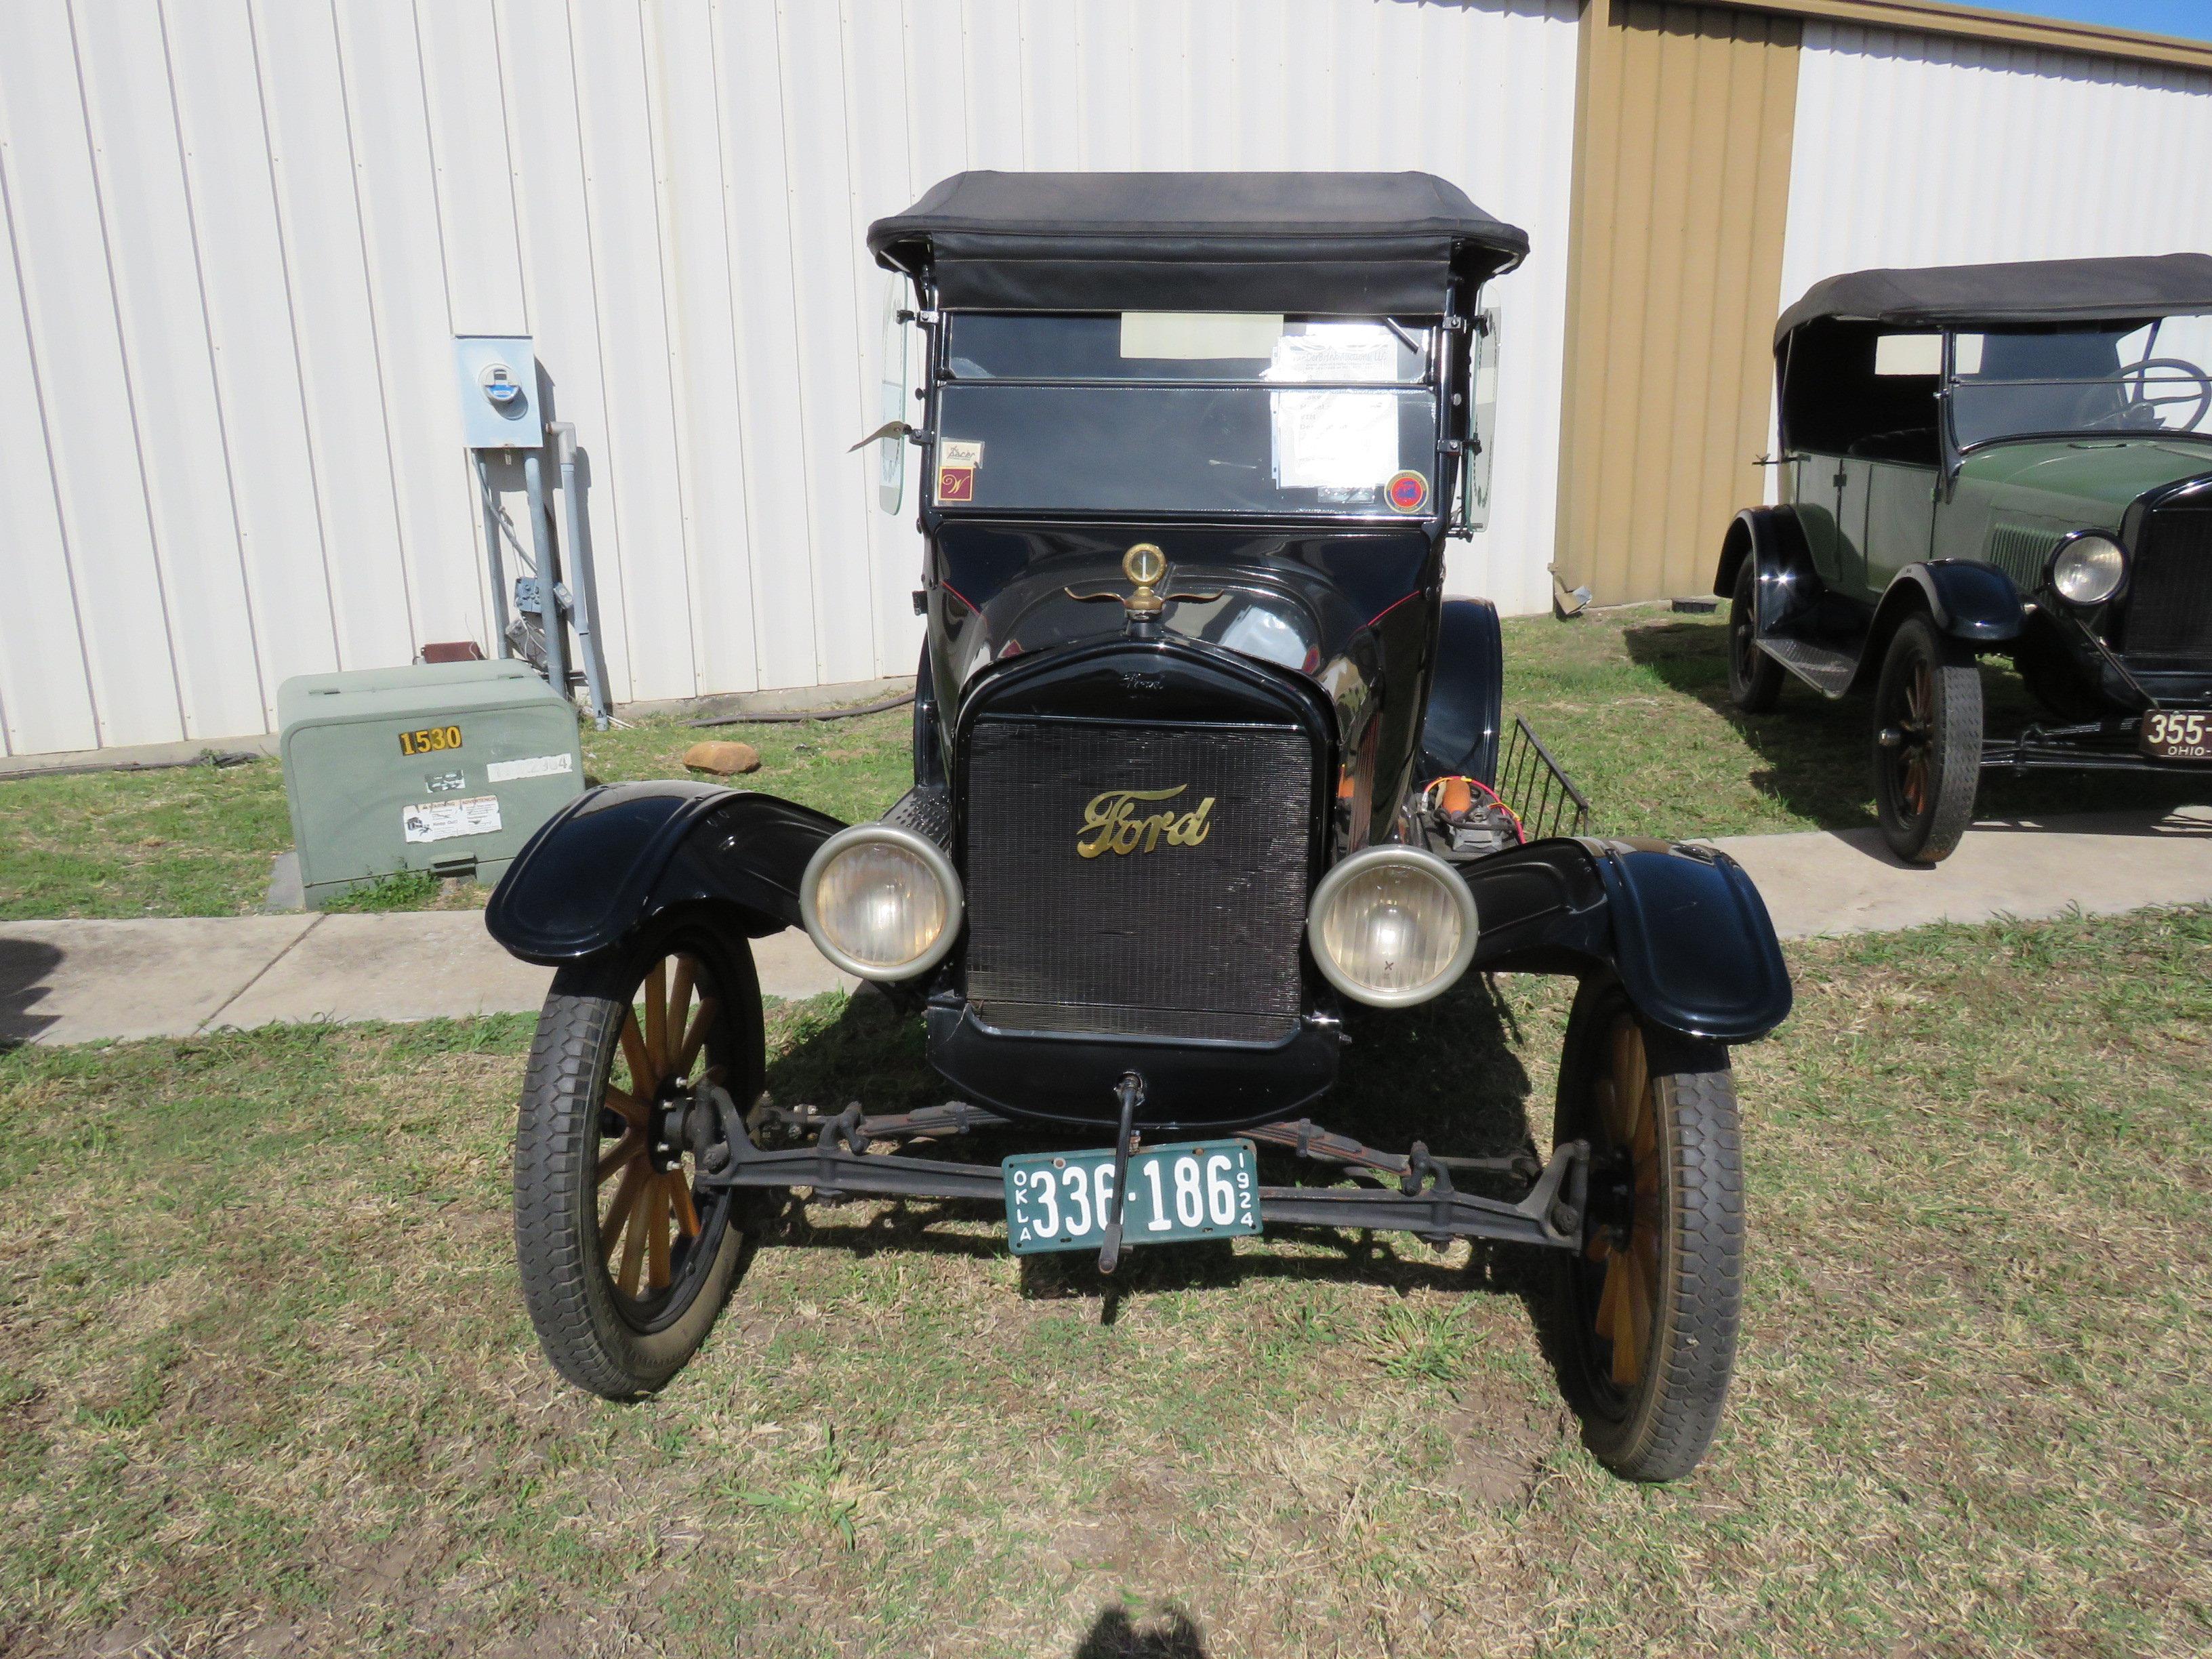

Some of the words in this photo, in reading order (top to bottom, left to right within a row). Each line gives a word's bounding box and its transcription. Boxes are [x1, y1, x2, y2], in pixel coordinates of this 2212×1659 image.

[400, 726, 462, 756] 1530
[1076, 783, 1216, 859] Ford
[1013, 1170, 1032, 1242] OKLA
[1236, 1152, 1254, 1227] 1924
